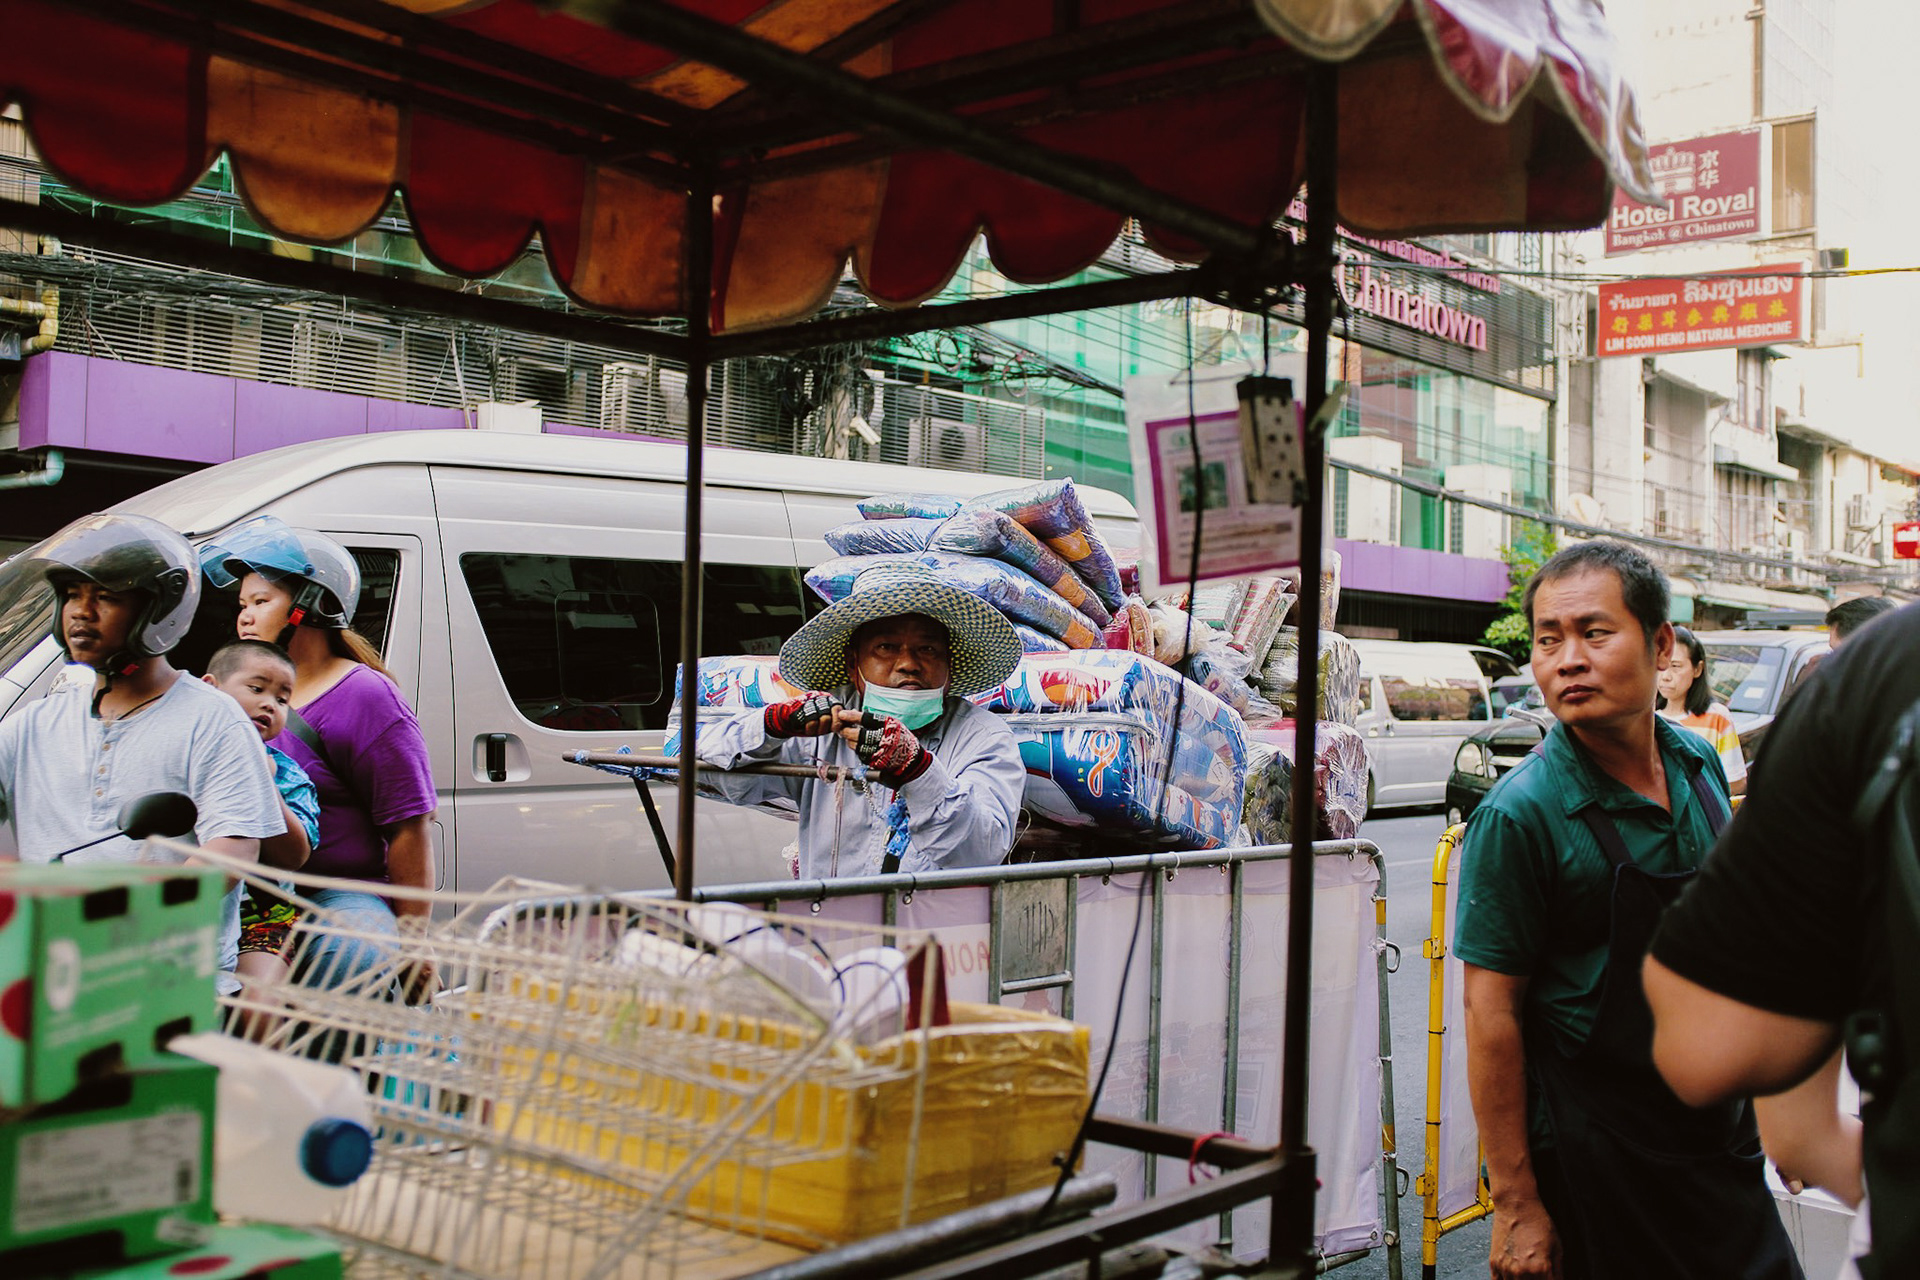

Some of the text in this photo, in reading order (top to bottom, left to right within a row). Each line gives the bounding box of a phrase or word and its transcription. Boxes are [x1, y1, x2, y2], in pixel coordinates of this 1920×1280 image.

[1611, 186, 1756, 229] Hotel Royal
[1611, 228, 1667, 247] Bangkok
[1685, 218, 1756, 237] Chinatown
[1336, 249, 1488, 352] Chinatown
[1605, 320, 1793, 352] LIM SOON HENG NATURAL MEDICINE
